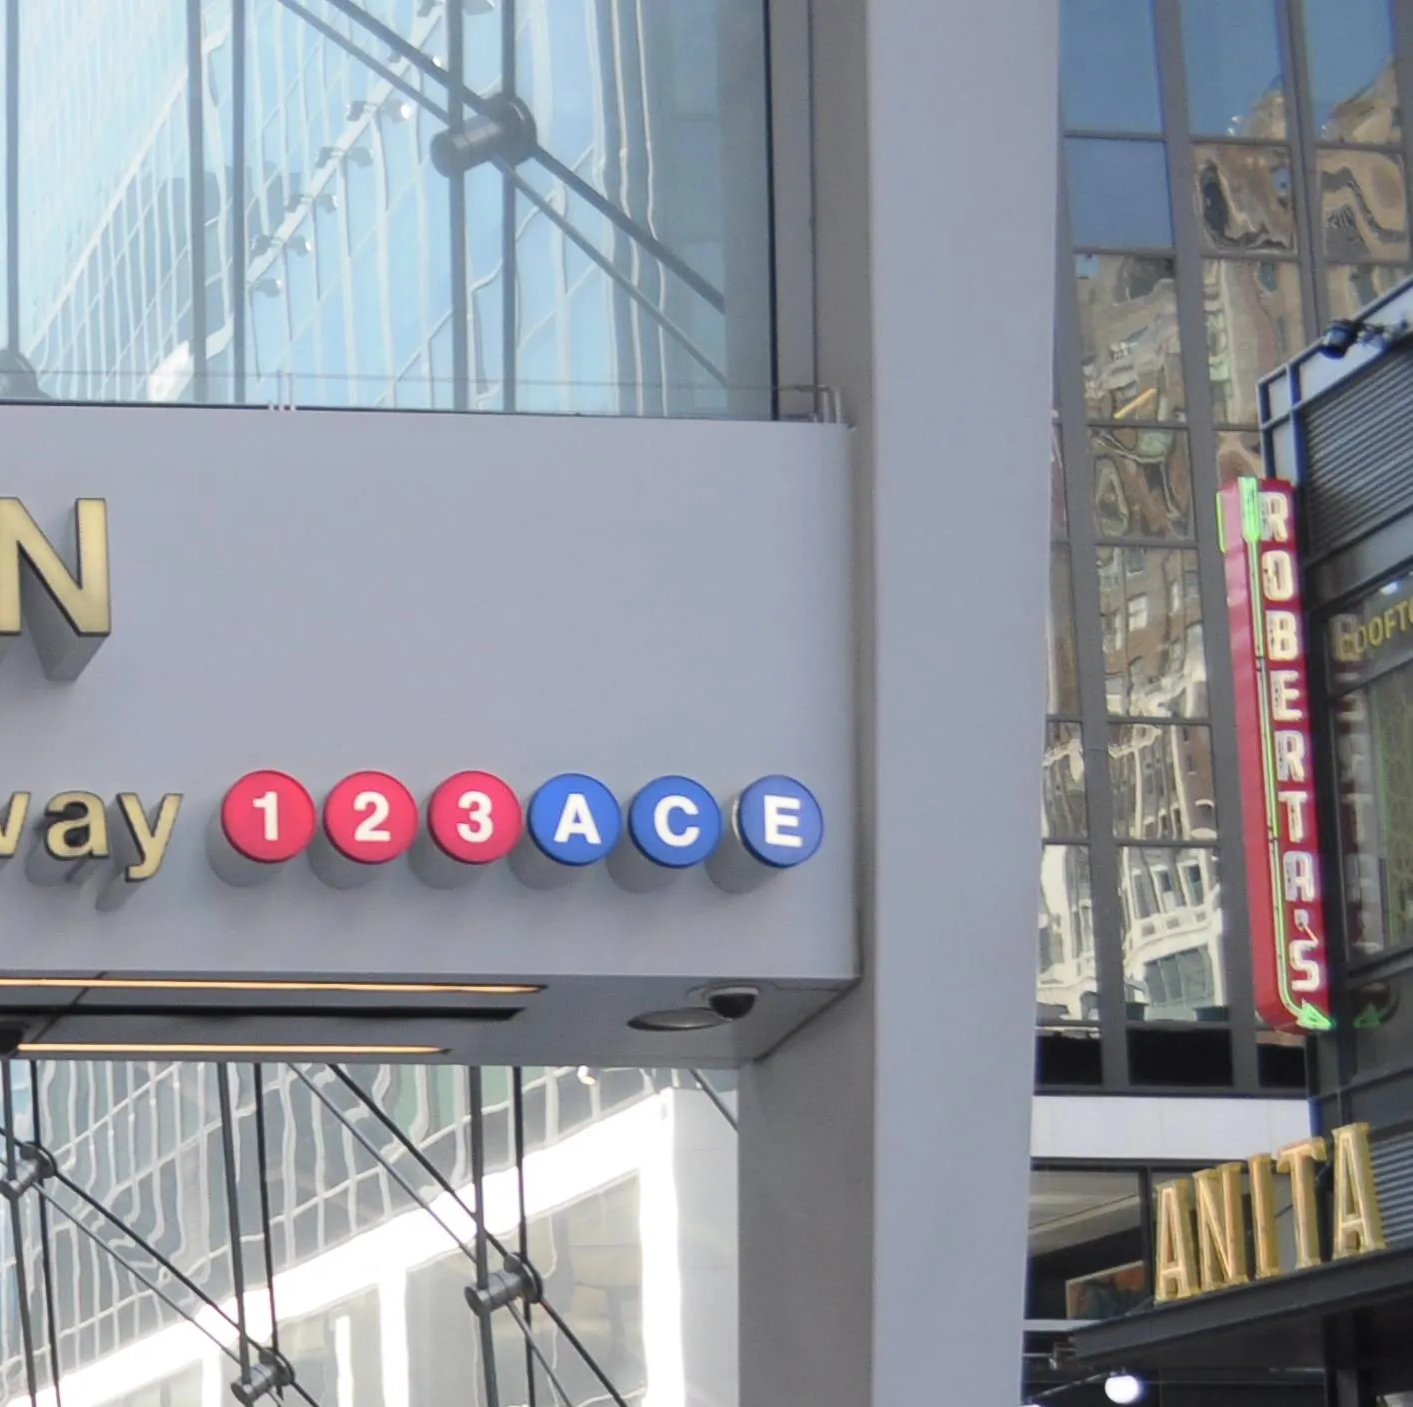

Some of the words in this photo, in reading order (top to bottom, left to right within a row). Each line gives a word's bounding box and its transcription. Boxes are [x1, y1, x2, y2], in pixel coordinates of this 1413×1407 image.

[251, 791, 278, 842] 1
[353, 791, 392, 843] 2
[456, 791, 494, 844] 3
[553, 793, 602, 845] A
[653, 794, 701, 847] C
[762, 795, 803, 847] E
[1259, 490, 1322, 993] ROBERTA'S
[1155, 1122, 1387, 1305] ANITA
